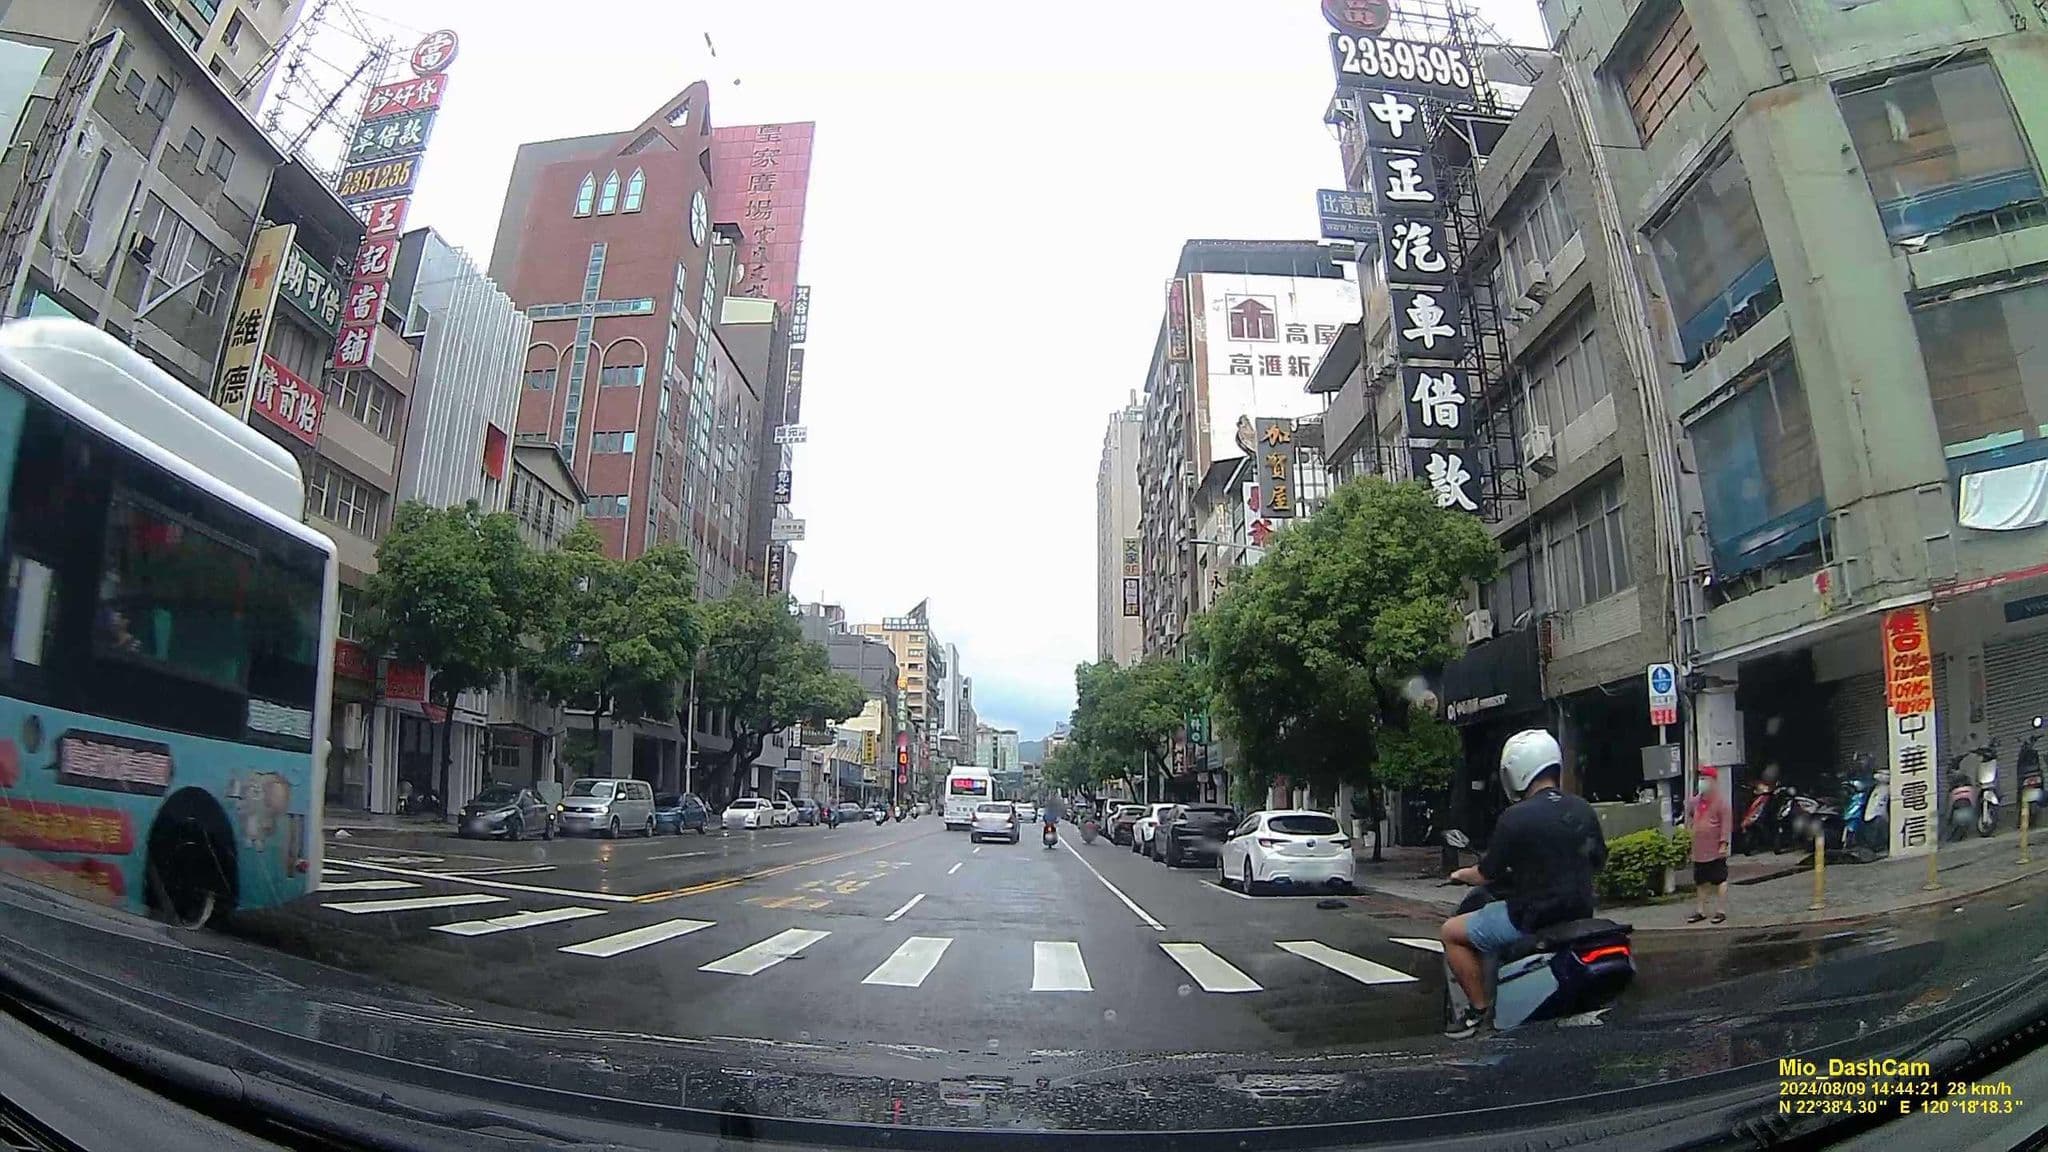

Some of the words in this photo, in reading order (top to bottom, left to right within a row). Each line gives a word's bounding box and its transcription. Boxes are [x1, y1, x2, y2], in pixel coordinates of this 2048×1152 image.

[1337, 35, 1470, 89] 2359595
[340, 160, 414, 196] 2351235
[1368, 93, 1479, 512] 中正汽車借款
[1899, 714, 1928, 848] 中華電信
